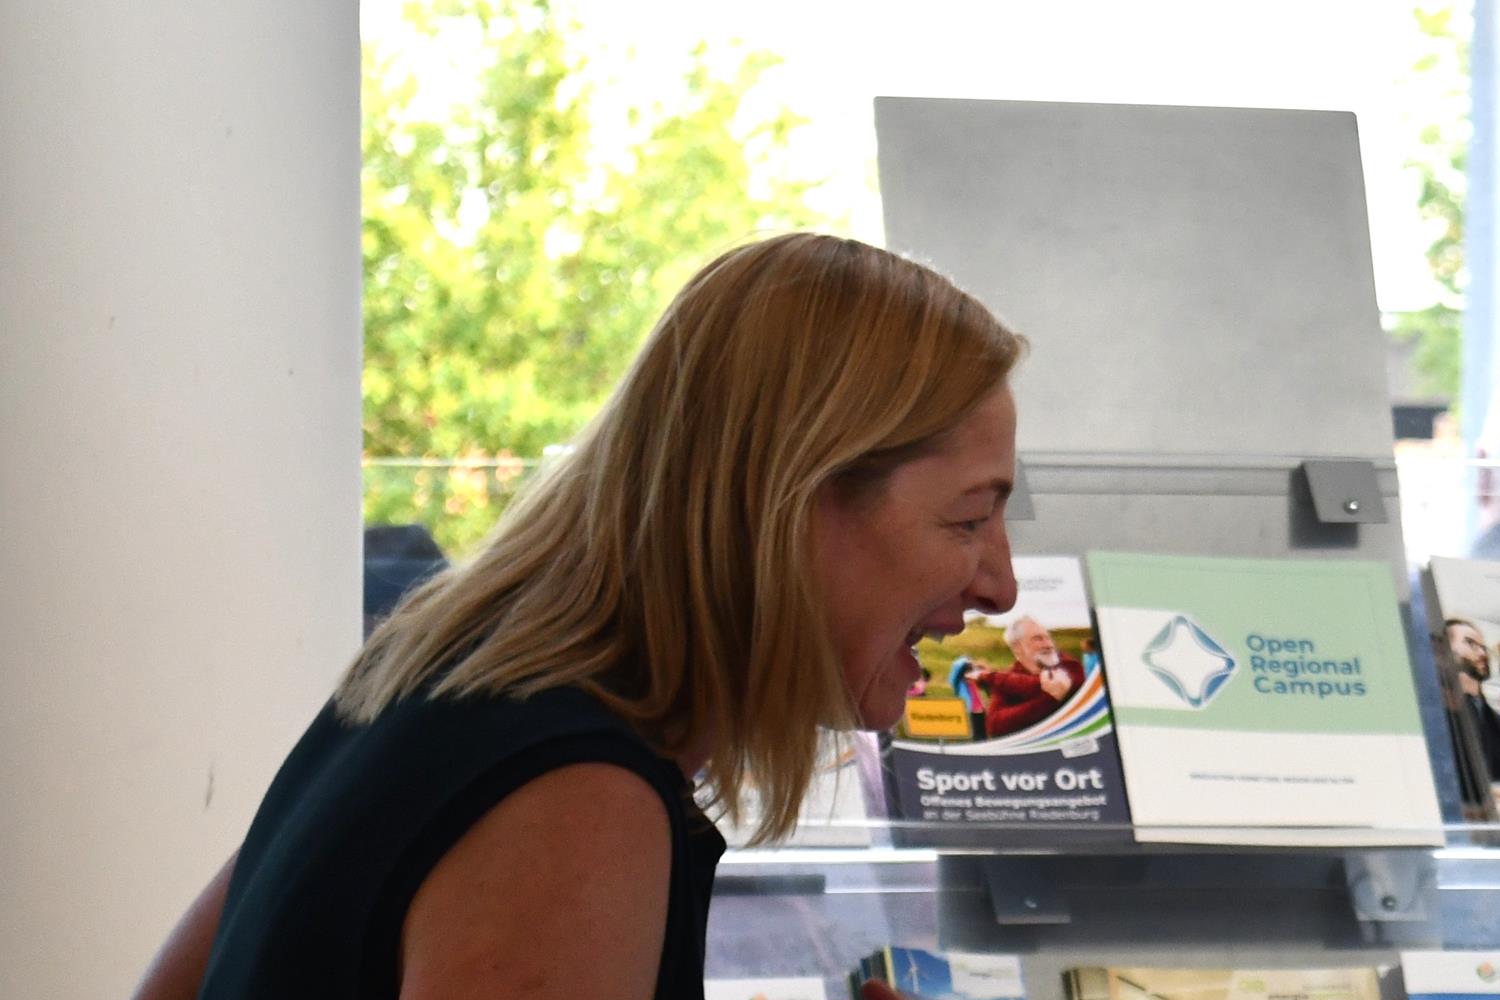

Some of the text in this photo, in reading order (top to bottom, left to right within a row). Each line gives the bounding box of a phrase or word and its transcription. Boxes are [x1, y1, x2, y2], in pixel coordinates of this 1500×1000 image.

[1246, 634, 1314, 655] Open
[1250, 655, 1360, 678] Regional
[1254, 676, 1366, 699] Campus
[916, 767, 1104, 795] Sport vor Ort
